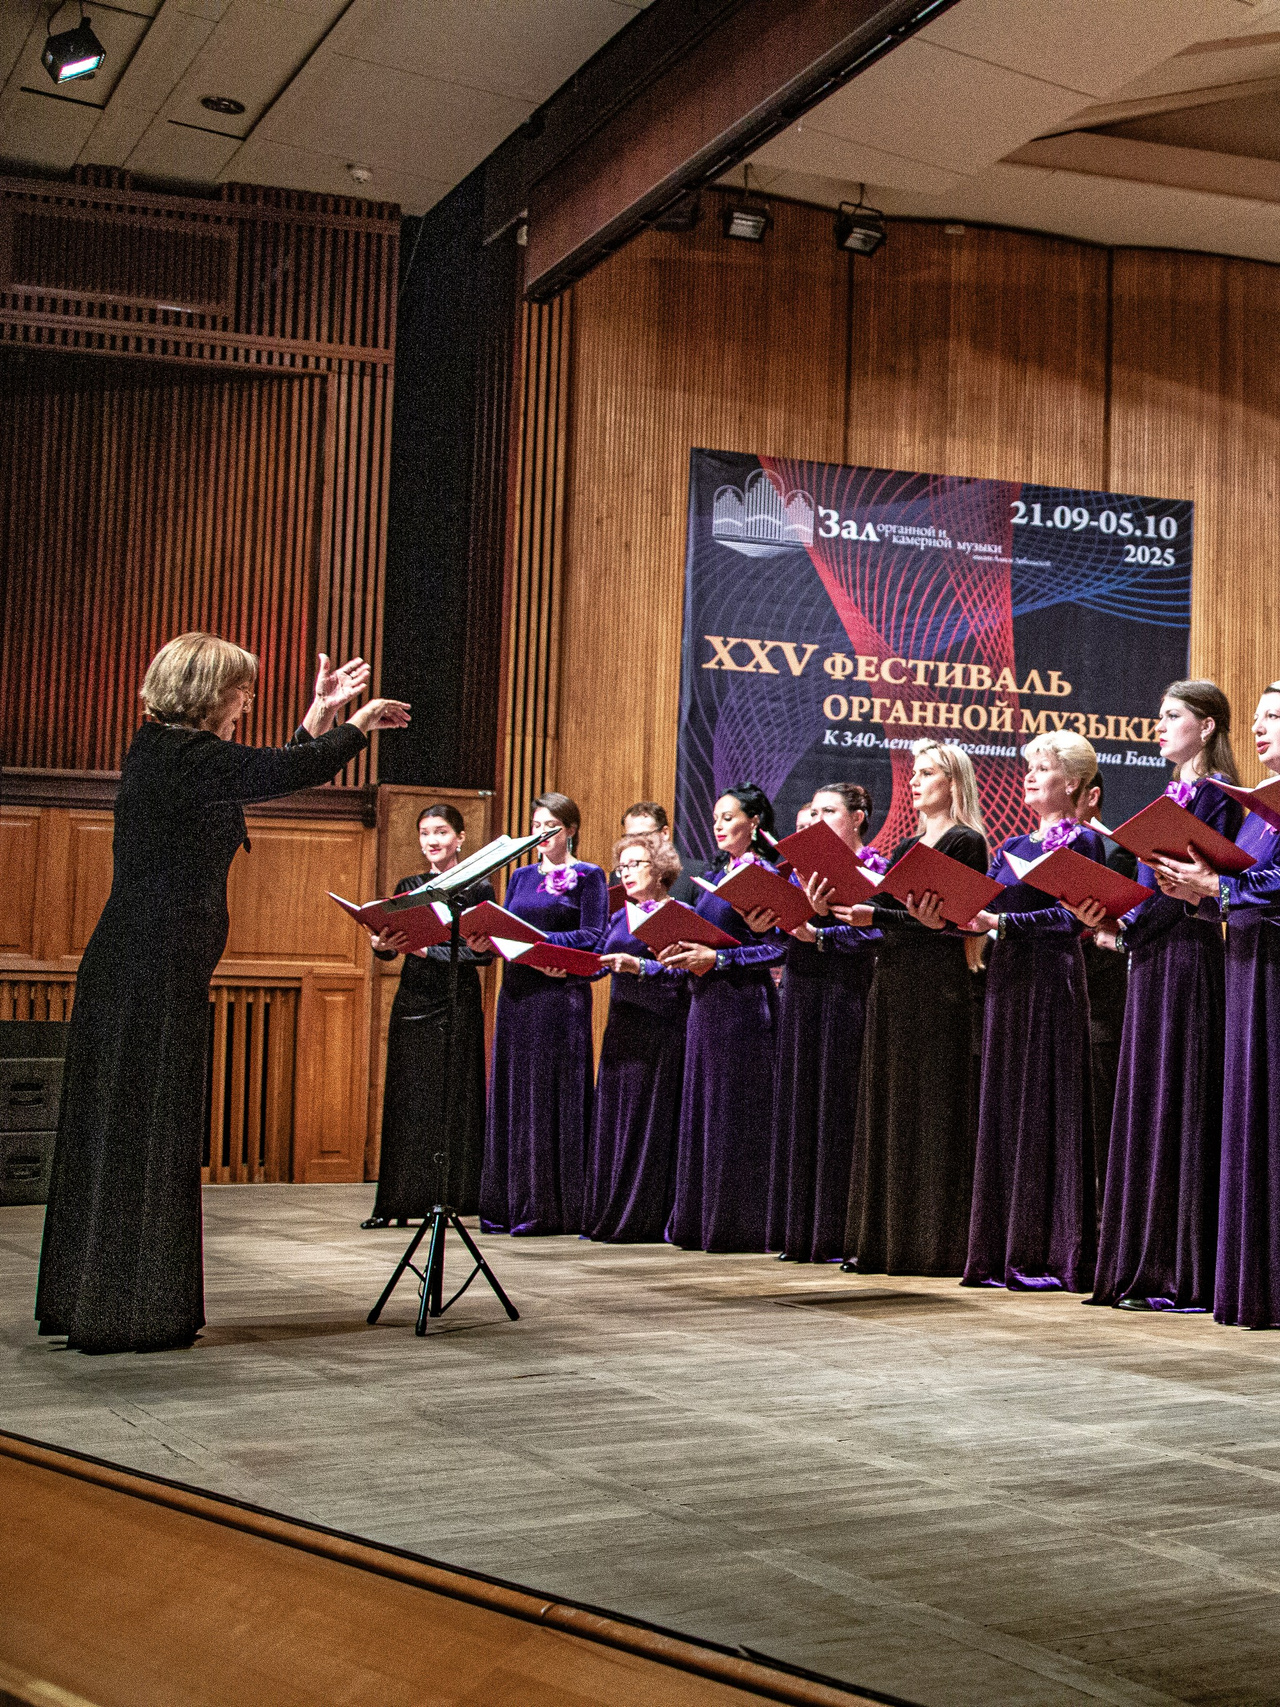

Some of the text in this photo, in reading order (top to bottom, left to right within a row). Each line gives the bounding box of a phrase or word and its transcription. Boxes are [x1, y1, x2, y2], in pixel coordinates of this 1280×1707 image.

[818, 505, 880, 542] Зал
[876, 523, 947, 539] органной и
[1010, 500, 1178, 540] 21.09-05.10
[892, 534, 1003, 555] камерной музыки
[1123, 544, 1176, 567] 2025
[702, 635, 1073, 697] XXV ФЕСТИВАЛЬ
[823, 694, 1161, 743] ОРГАННОЙ МУЗЫКИ
[822, 729, 841, 746] К
[841, 731, 915, 751] 340-лет
[1124, 750, 1167, 768] Баха
